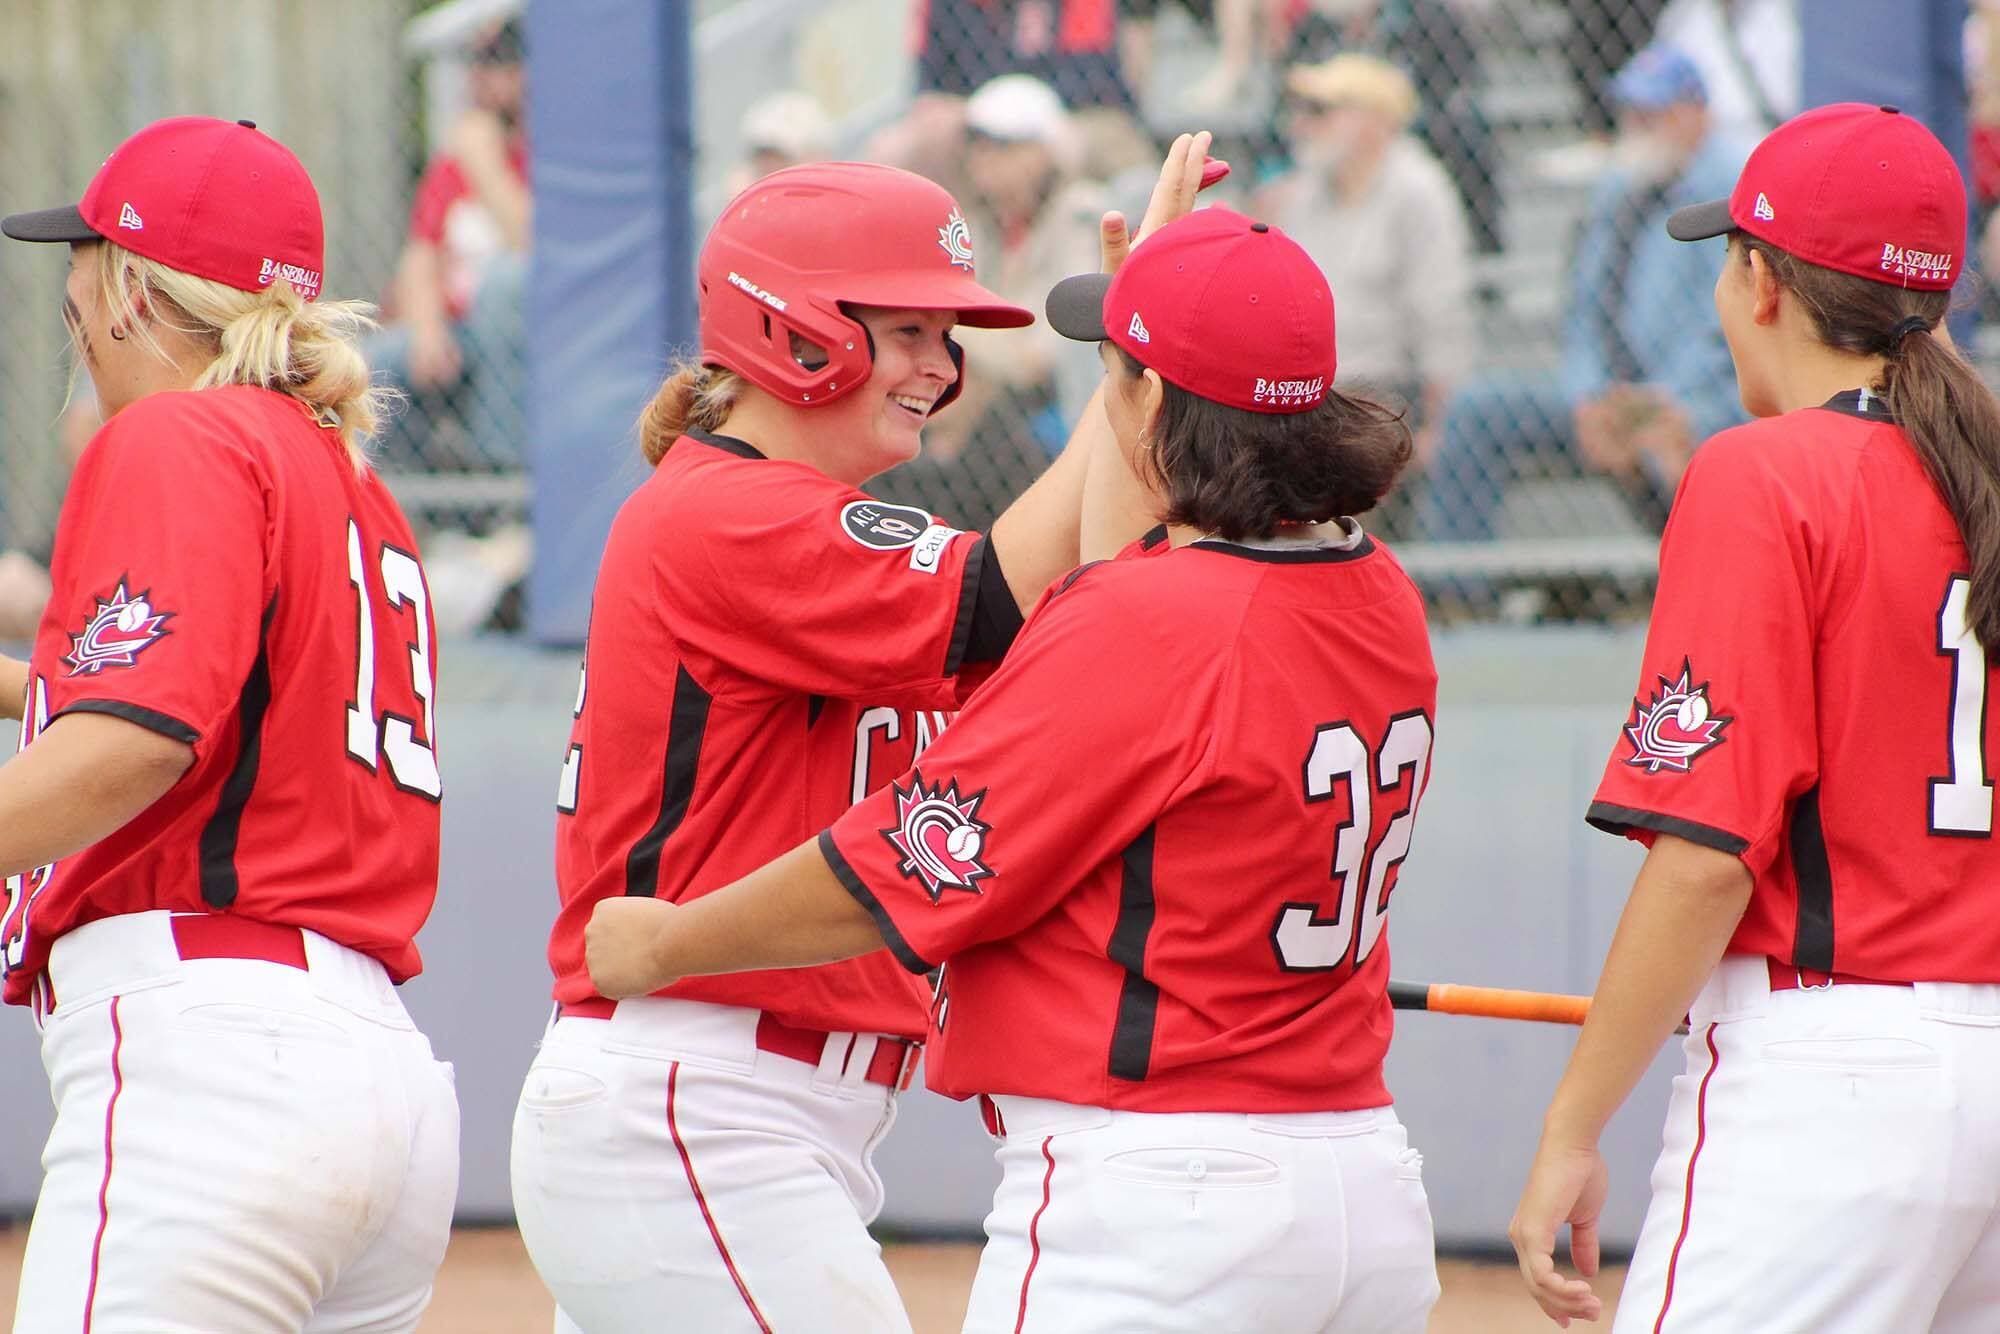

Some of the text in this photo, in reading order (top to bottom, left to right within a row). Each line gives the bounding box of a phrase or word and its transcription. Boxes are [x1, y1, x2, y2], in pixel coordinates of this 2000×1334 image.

[1881, 243, 1952, 271] BASEBALL
[259, 257, 320, 288] BASEBALL
[1881, 261, 1949, 280] CANADA
[1254, 376, 1323, 396] BASEBALL
[1254, 391, 1321, 405] CANADA
[850, 505, 880, 528] ACE
[869, 517, 920, 541] 19
[345, 514, 442, 803] 13
[1271, 708, 1434, 972] 32
